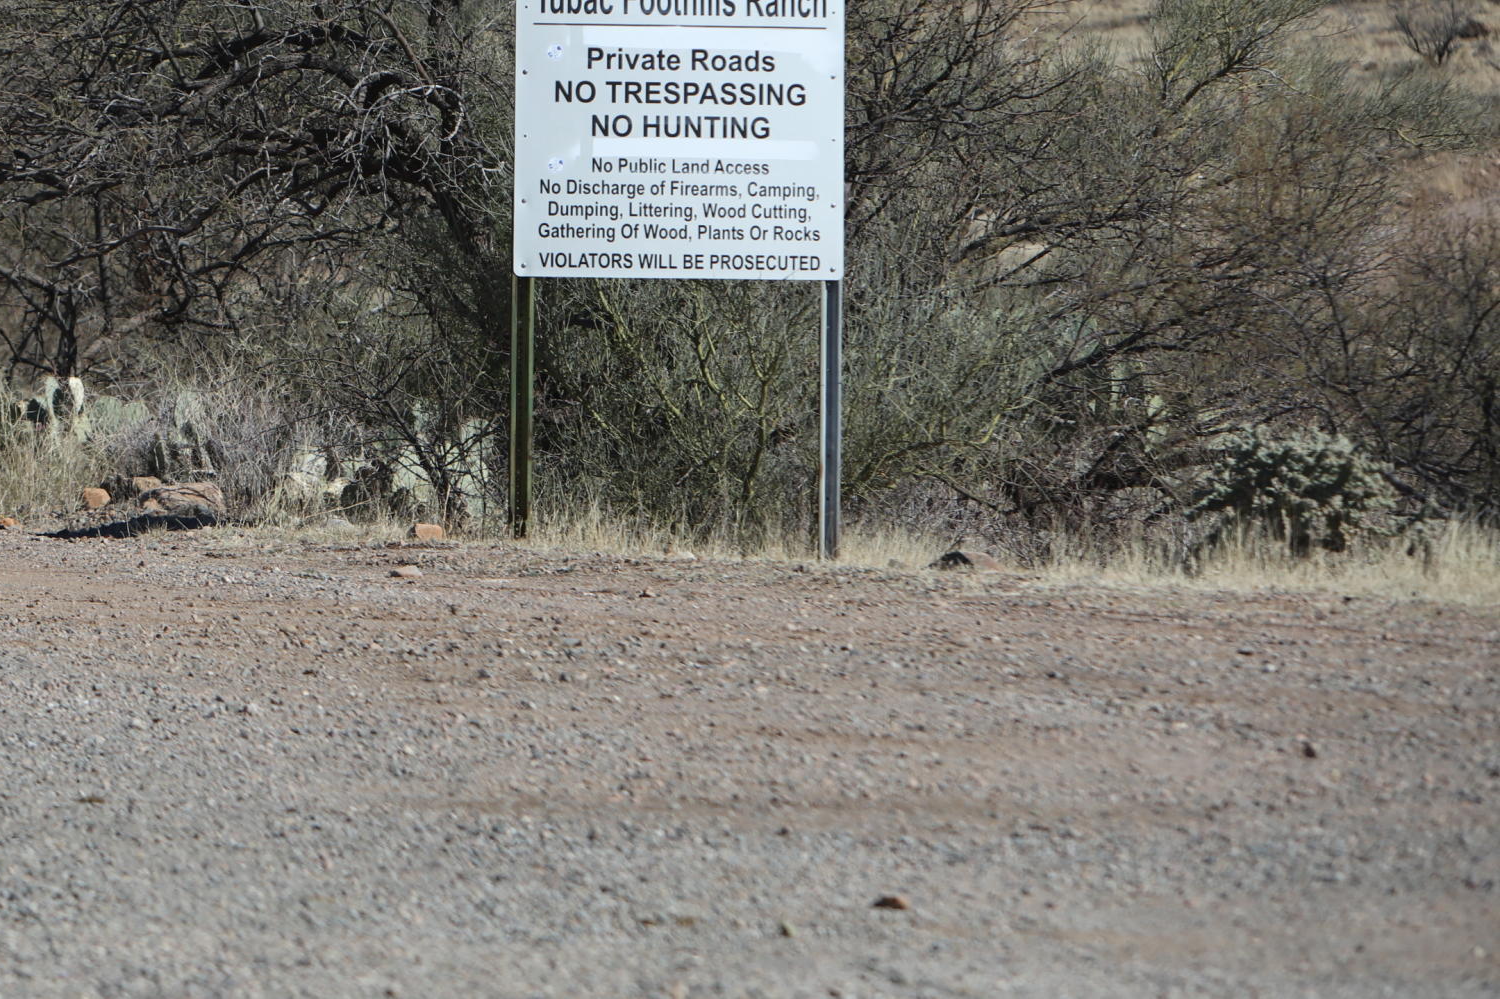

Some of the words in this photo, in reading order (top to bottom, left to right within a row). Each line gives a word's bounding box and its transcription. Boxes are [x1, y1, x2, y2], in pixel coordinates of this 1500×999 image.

[587, 47, 681, 71] Private
[691, 49, 775, 72] Roads
[555, 80, 596, 103] NO
[605, 81, 806, 106] TRESPASSING
[592, 114, 632, 137] NO
[643, 115, 770, 139] HUNTING
[592, 158, 613, 173] No
[618, 158, 666, 173] Public
[672, 159, 709, 174] Land
[714, 160, 769, 175] Access
[540, 179, 561, 194] No
[567, 179, 645, 197] Discharge
[650, 180, 666, 195] of
[671, 180, 741, 199] Firearms,
[748, 181, 819, 201] Camping,
[548, 201, 623, 220] Dumping,
[629, 202, 697, 222] Littering,
[703, 203, 746, 218] Wood
[752, 203, 811, 223] Cutting,
[538, 223, 615, 243] Gathering
[621, 223, 639, 239] Of
[643, 224, 691, 241] Wood,
[698, 225, 744, 240] Plants
[750, 226, 768, 240] Or
[774, 226, 820, 241] Rocks
[539, 252, 633, 269] VIOLATORS
[638, 254, 678, 269] WILL
[683, 254, 704, 269] BE
[710, 254, 820, 271] PROSECUTED
